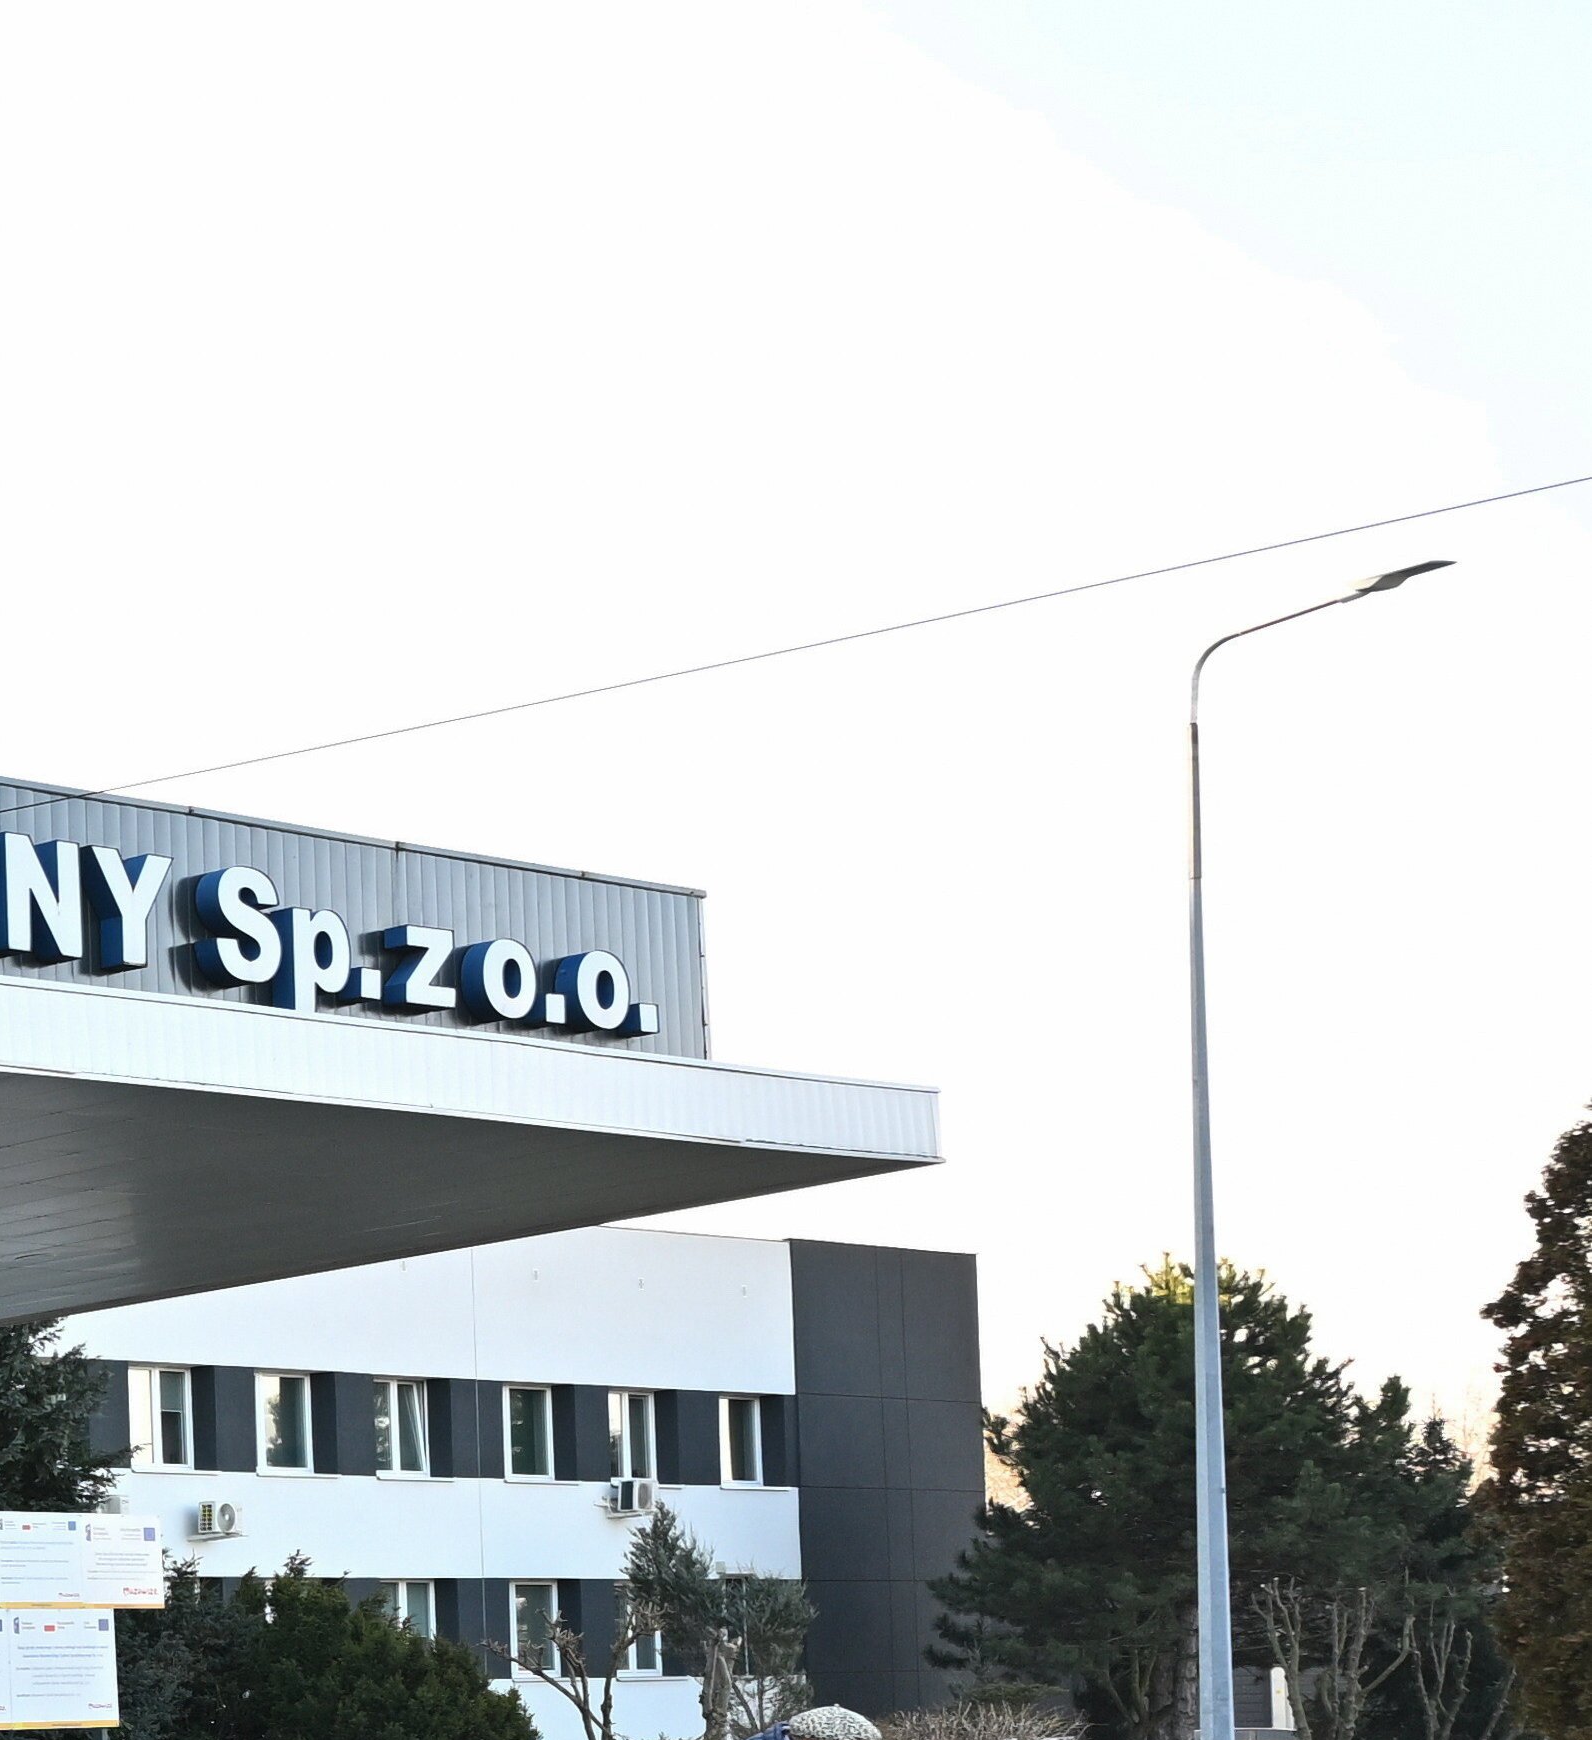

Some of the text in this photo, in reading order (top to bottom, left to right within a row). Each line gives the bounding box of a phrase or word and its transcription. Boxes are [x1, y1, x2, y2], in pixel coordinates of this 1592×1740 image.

[196, 866, 381, 1010] Sp.
[384, 924, 456, 1010] z
[460, 938, 659, 1034] o.o.
